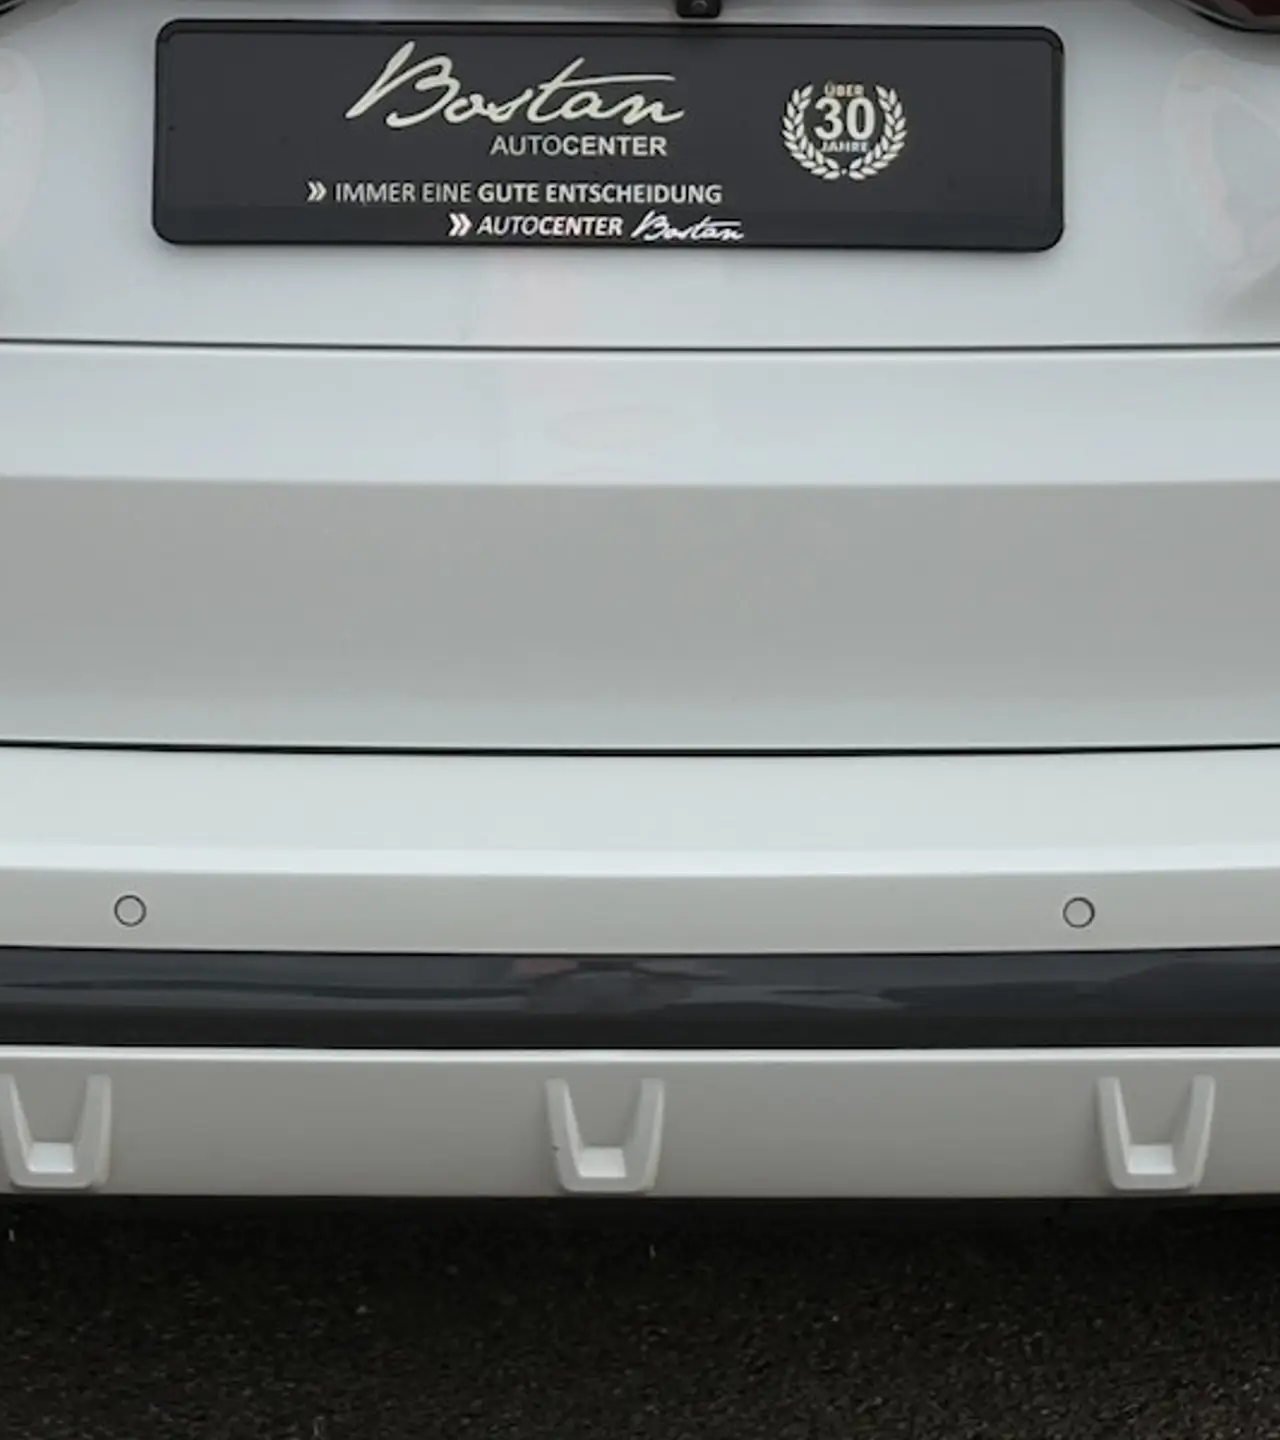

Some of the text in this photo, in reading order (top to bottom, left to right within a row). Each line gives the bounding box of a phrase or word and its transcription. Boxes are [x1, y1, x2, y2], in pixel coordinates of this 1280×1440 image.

[345, 40, 685, 128] Bostan
[824, 81, 865, 97] ÜBER
[813, 97, 876, 141] 30
[489, 135, 668, 157] AUTOCENTER
[335, 182, 723, 205] IMMER EINE GUTE ENTSCHEIDUNG
[477, 210, 745, 241] AUTOCENTER Bostan
